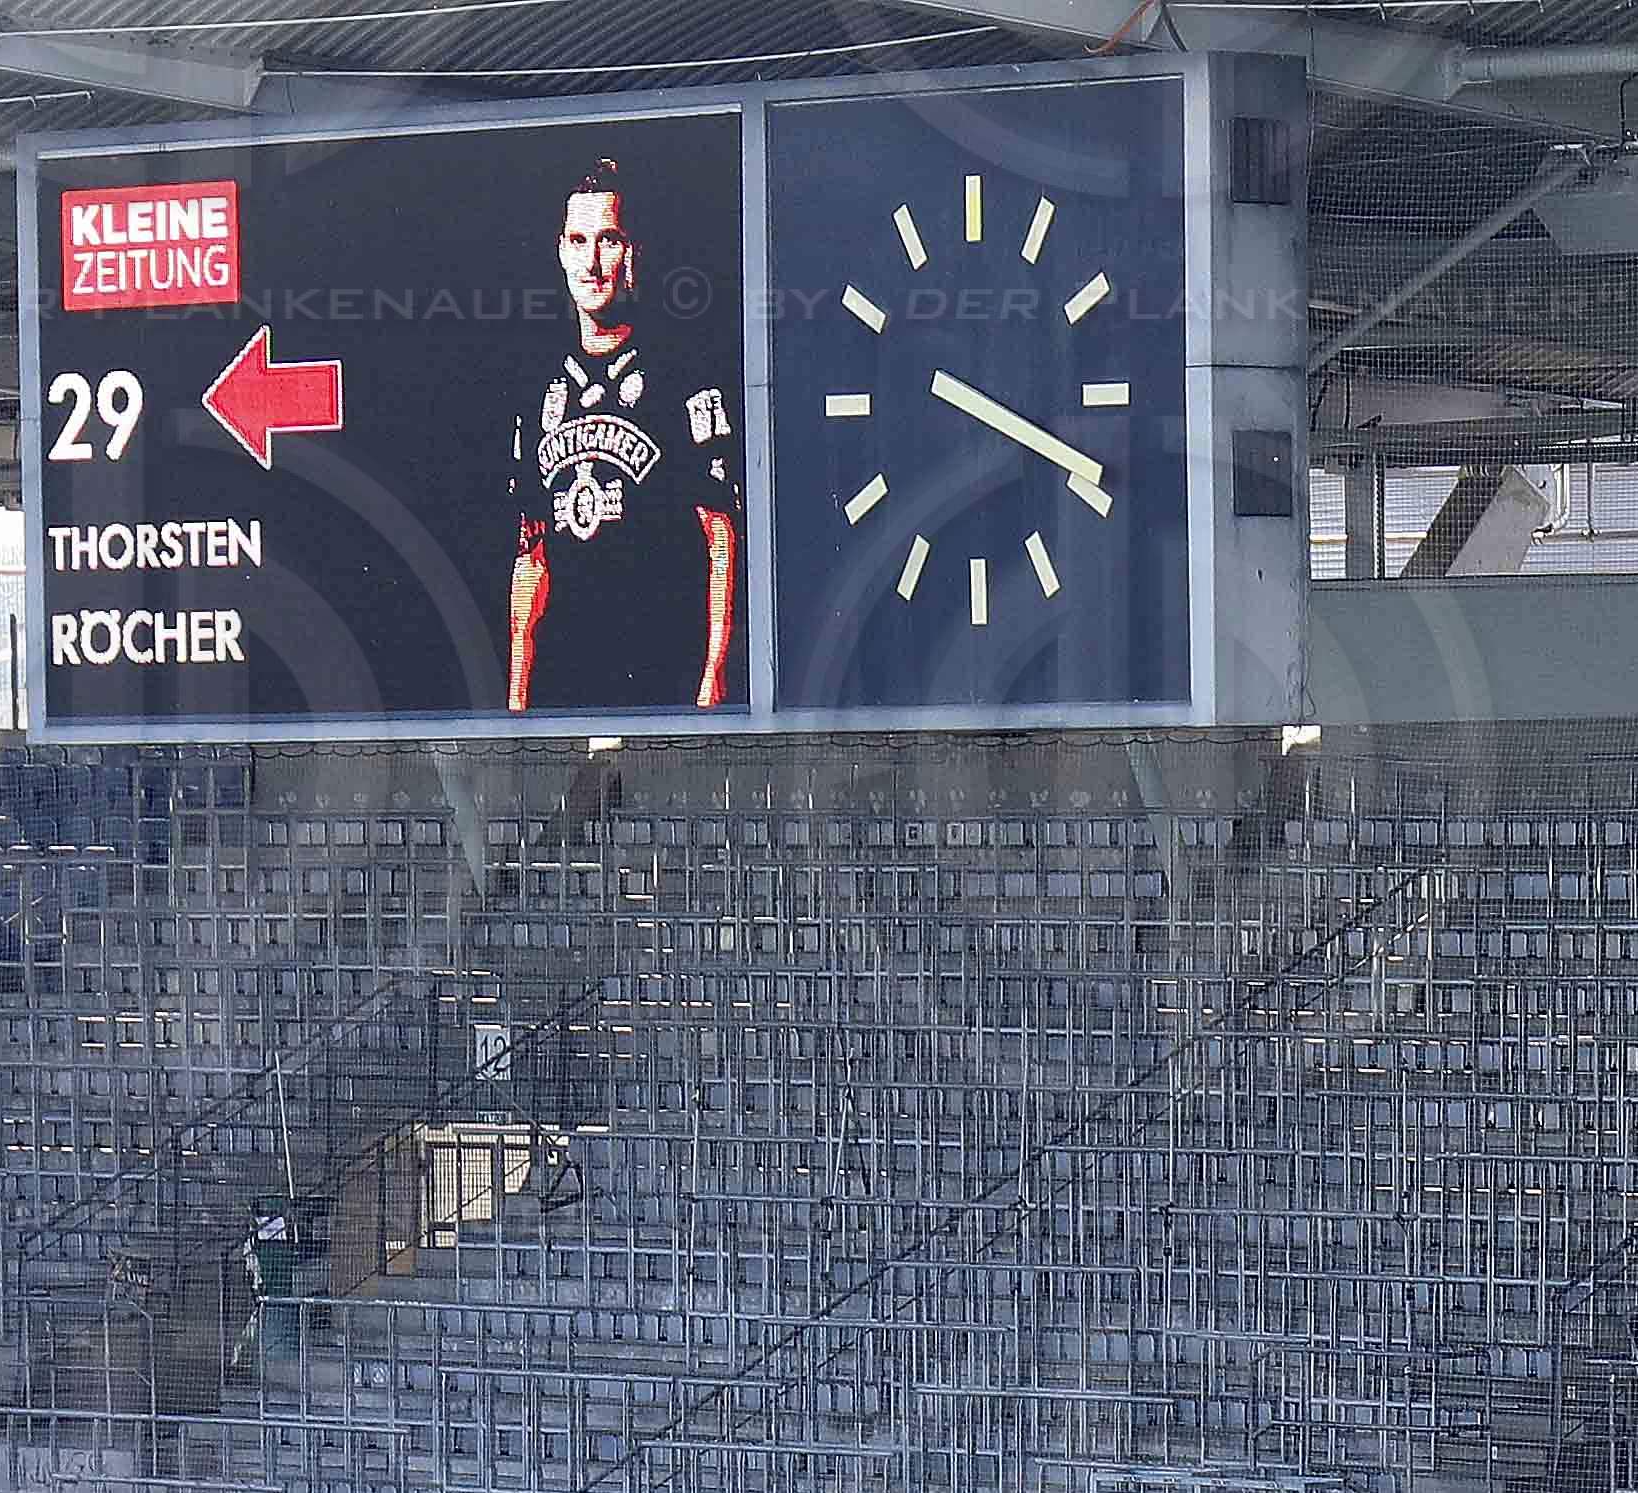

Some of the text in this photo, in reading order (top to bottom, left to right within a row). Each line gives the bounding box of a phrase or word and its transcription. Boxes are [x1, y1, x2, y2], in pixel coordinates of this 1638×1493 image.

[71, 197, 229, 245] KLEINE
[72, 245, 229, 294] ZEITUNG
[48, 370, 143, 460] 29
[48, 519, 262, 571] THORSTEN
[51, 608, 245, 665] RÖCHER
